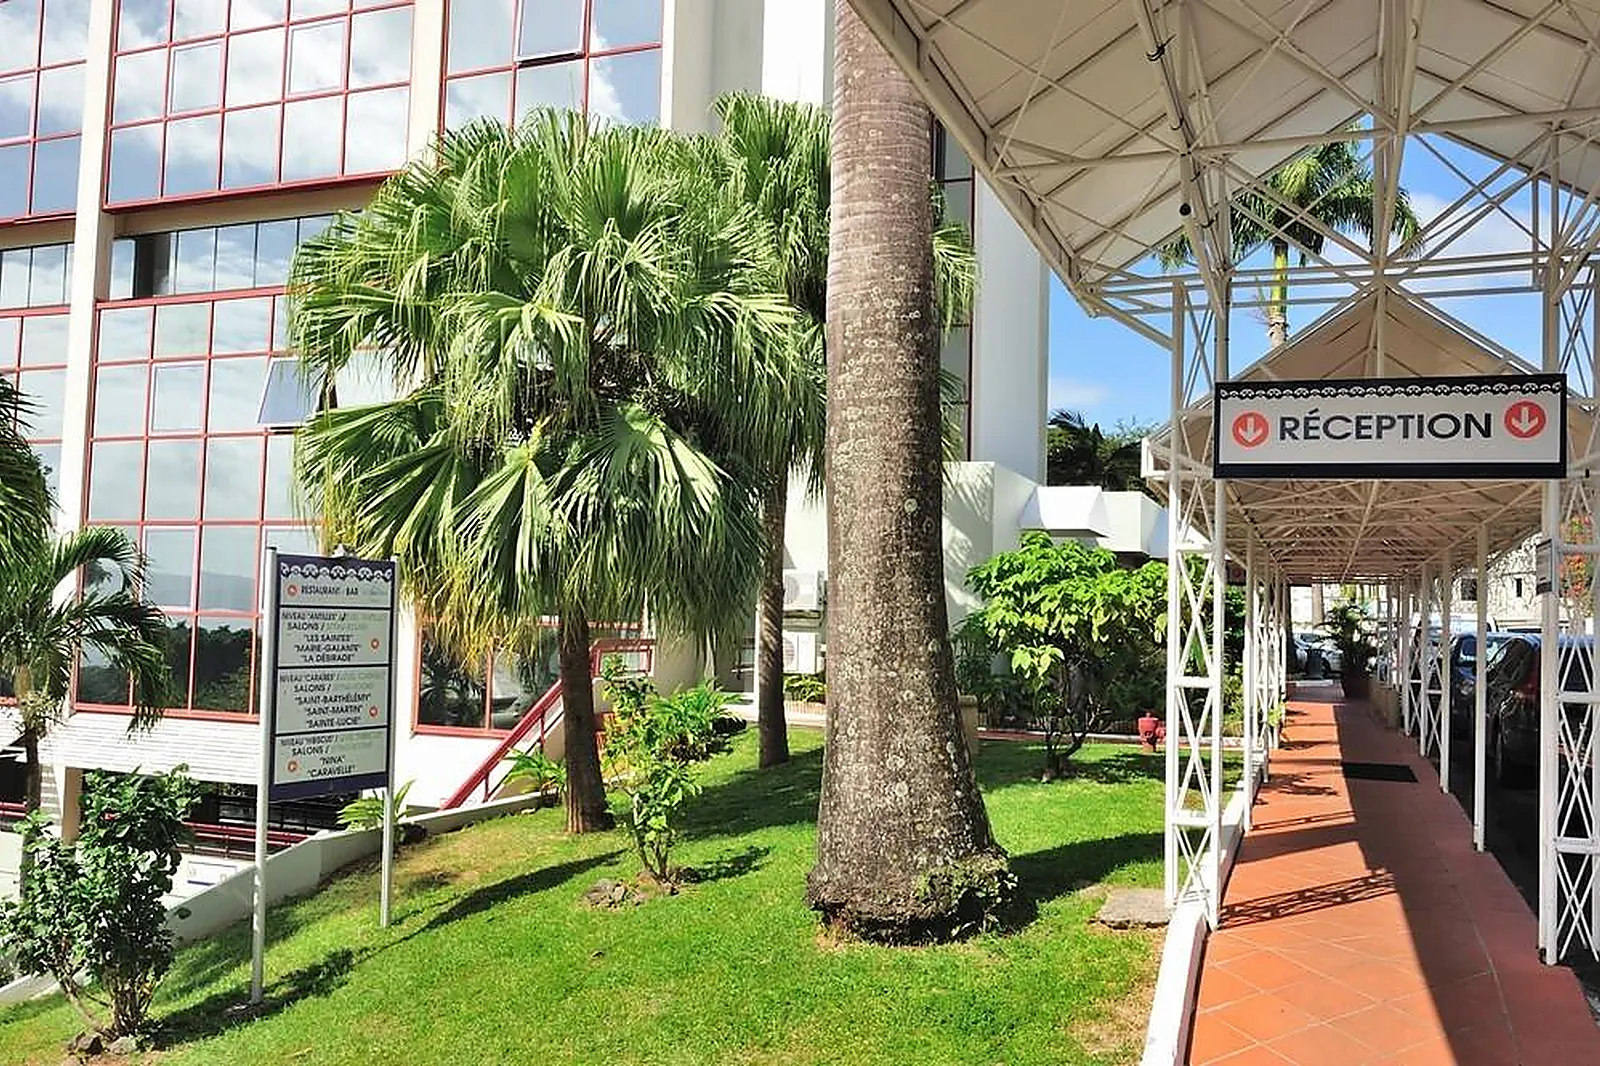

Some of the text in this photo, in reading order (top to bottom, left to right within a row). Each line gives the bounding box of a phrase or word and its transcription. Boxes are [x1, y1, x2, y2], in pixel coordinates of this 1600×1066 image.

[1279, 408, 1492, 441] RÉCEPTION
[346, 586, 358, 596] BAR
[287, 622, 318, 630] SALONS
[294, 684, 325, 693] SALONS
[292, 746, 324, 756] SALONS
